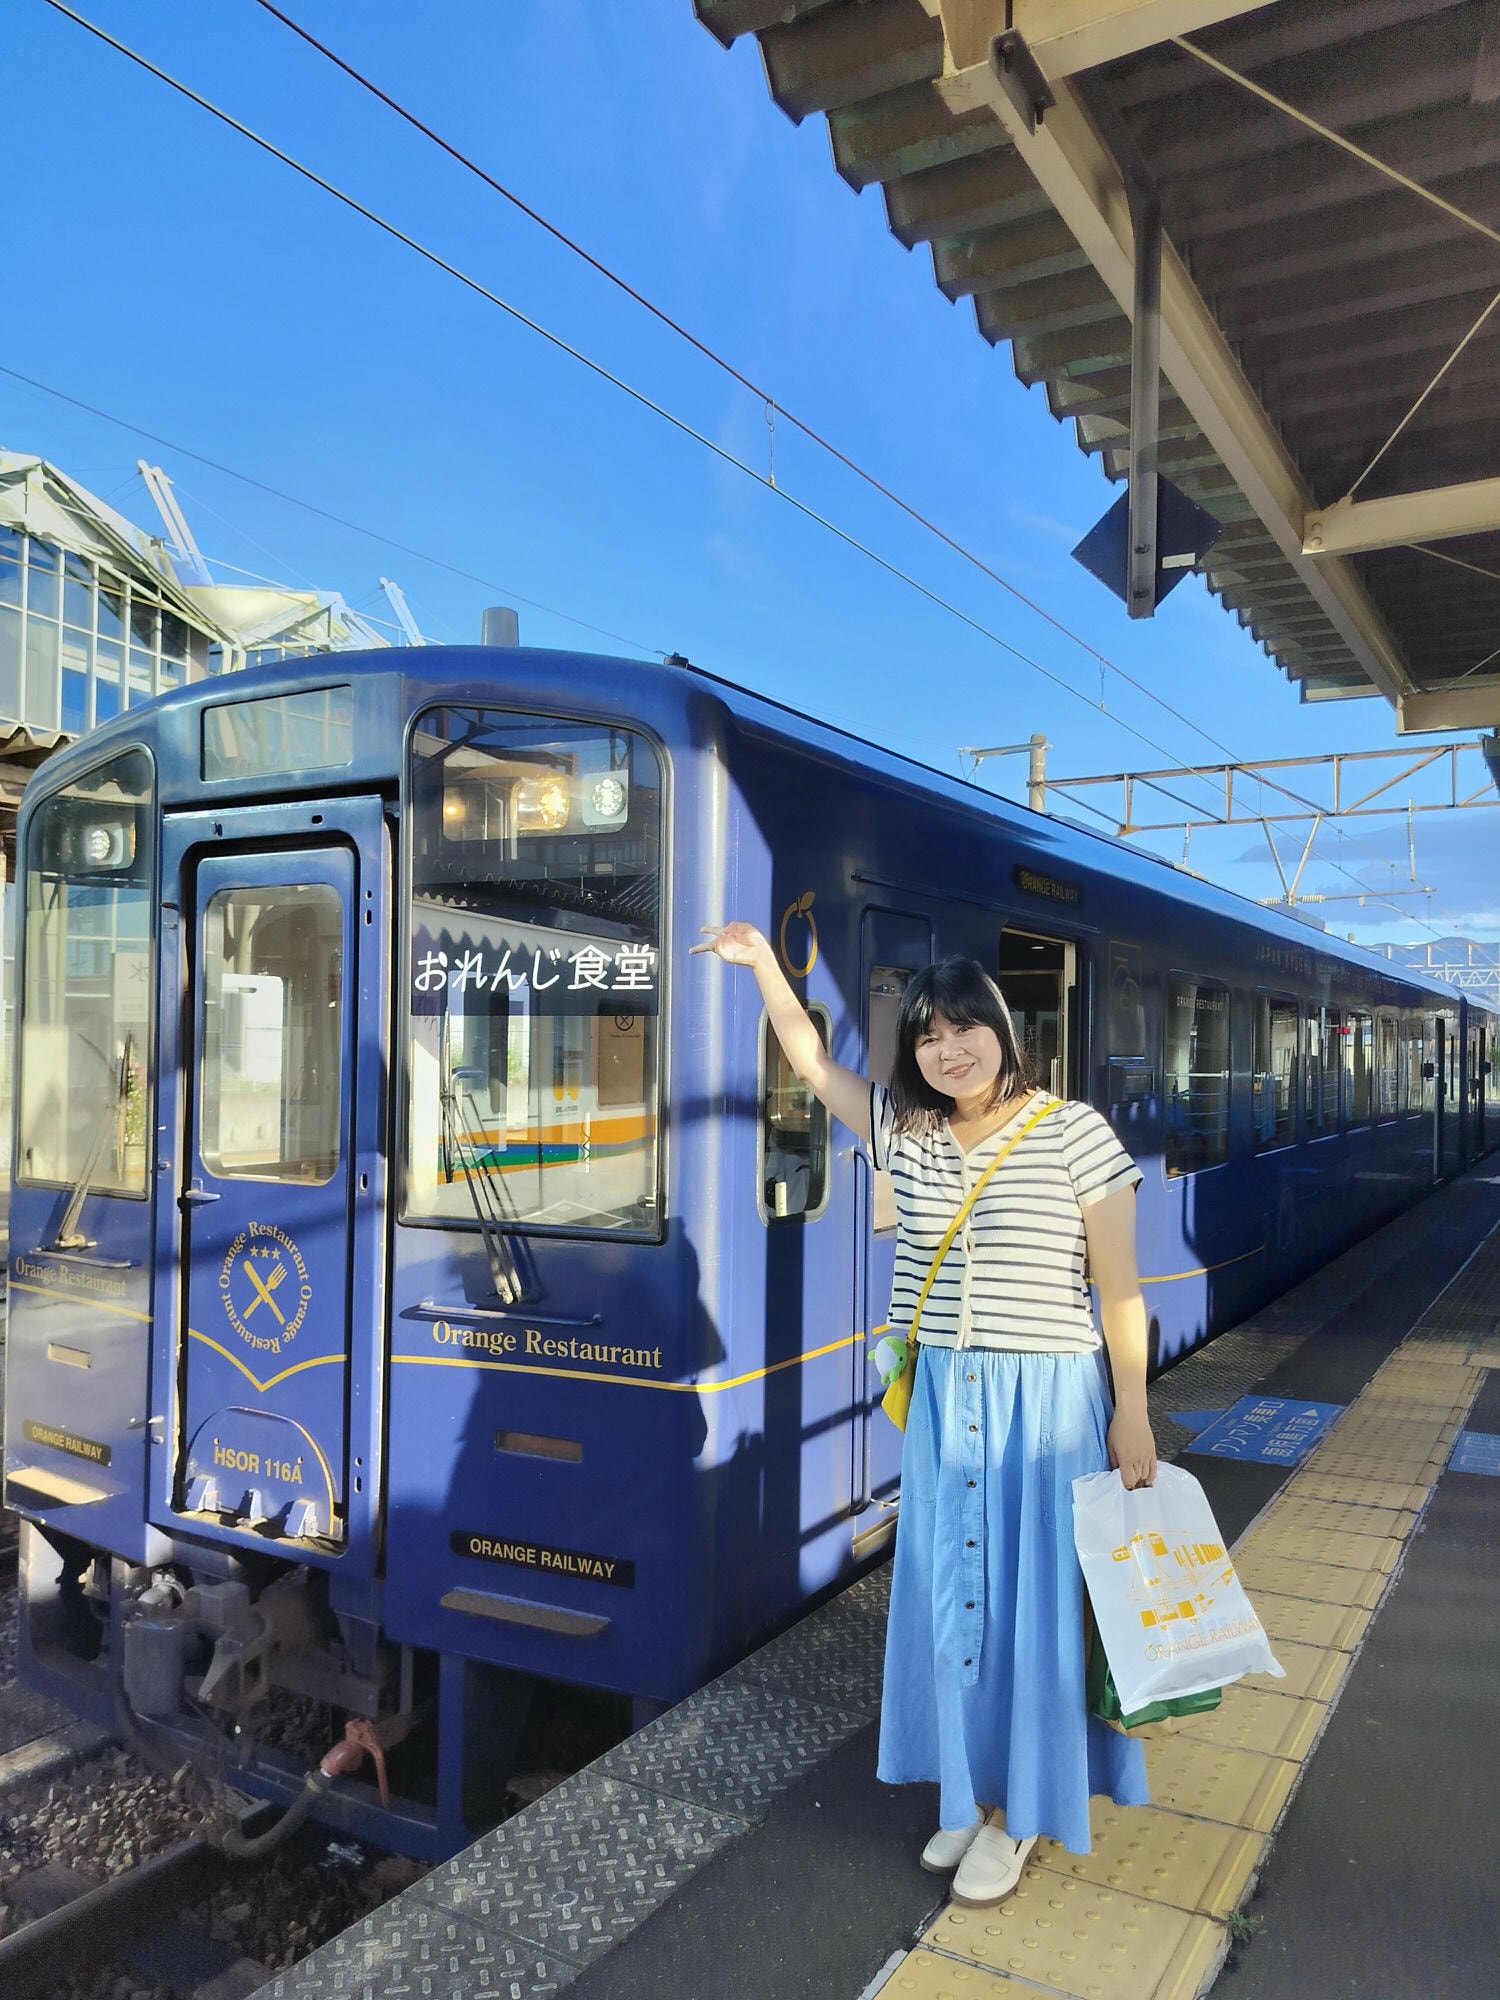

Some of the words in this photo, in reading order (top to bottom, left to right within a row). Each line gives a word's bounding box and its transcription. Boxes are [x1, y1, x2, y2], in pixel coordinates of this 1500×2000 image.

[414, 943, 656, 993] おれんじ食堂
[218, 1232, 247, 1289] Orange
[248, 1221, 310, 1281] Restaurant
[15, 1256, 57, 1285] Orange
[60, 1264, 127, 1297] Restaurant
[221, 1291, 282, 1354] Restaurant
[281, 1284, 313, 1344] Orange
[432, 1320, 517, 1355] Orange
[524, 1329, 663, 1369] Restaurant
[32, 1426, 65, 1447] ORANGE
[65, 1438, 103, 1460] RAILWAY
[1210, 1400, 1285, 1453] ワンマン乗車口
[1260, 1416, 1320, 1458] 鹿児島方面
[214, 1446, 260, 1474] HSOR
[264, 1458, 303, 1485] 116A
[469, 1538, 537, 1564] ORANGE
[541, 1551, 616, 1579] RAILWAY
[1143, 1631, 1209, 1662] ORANGE
